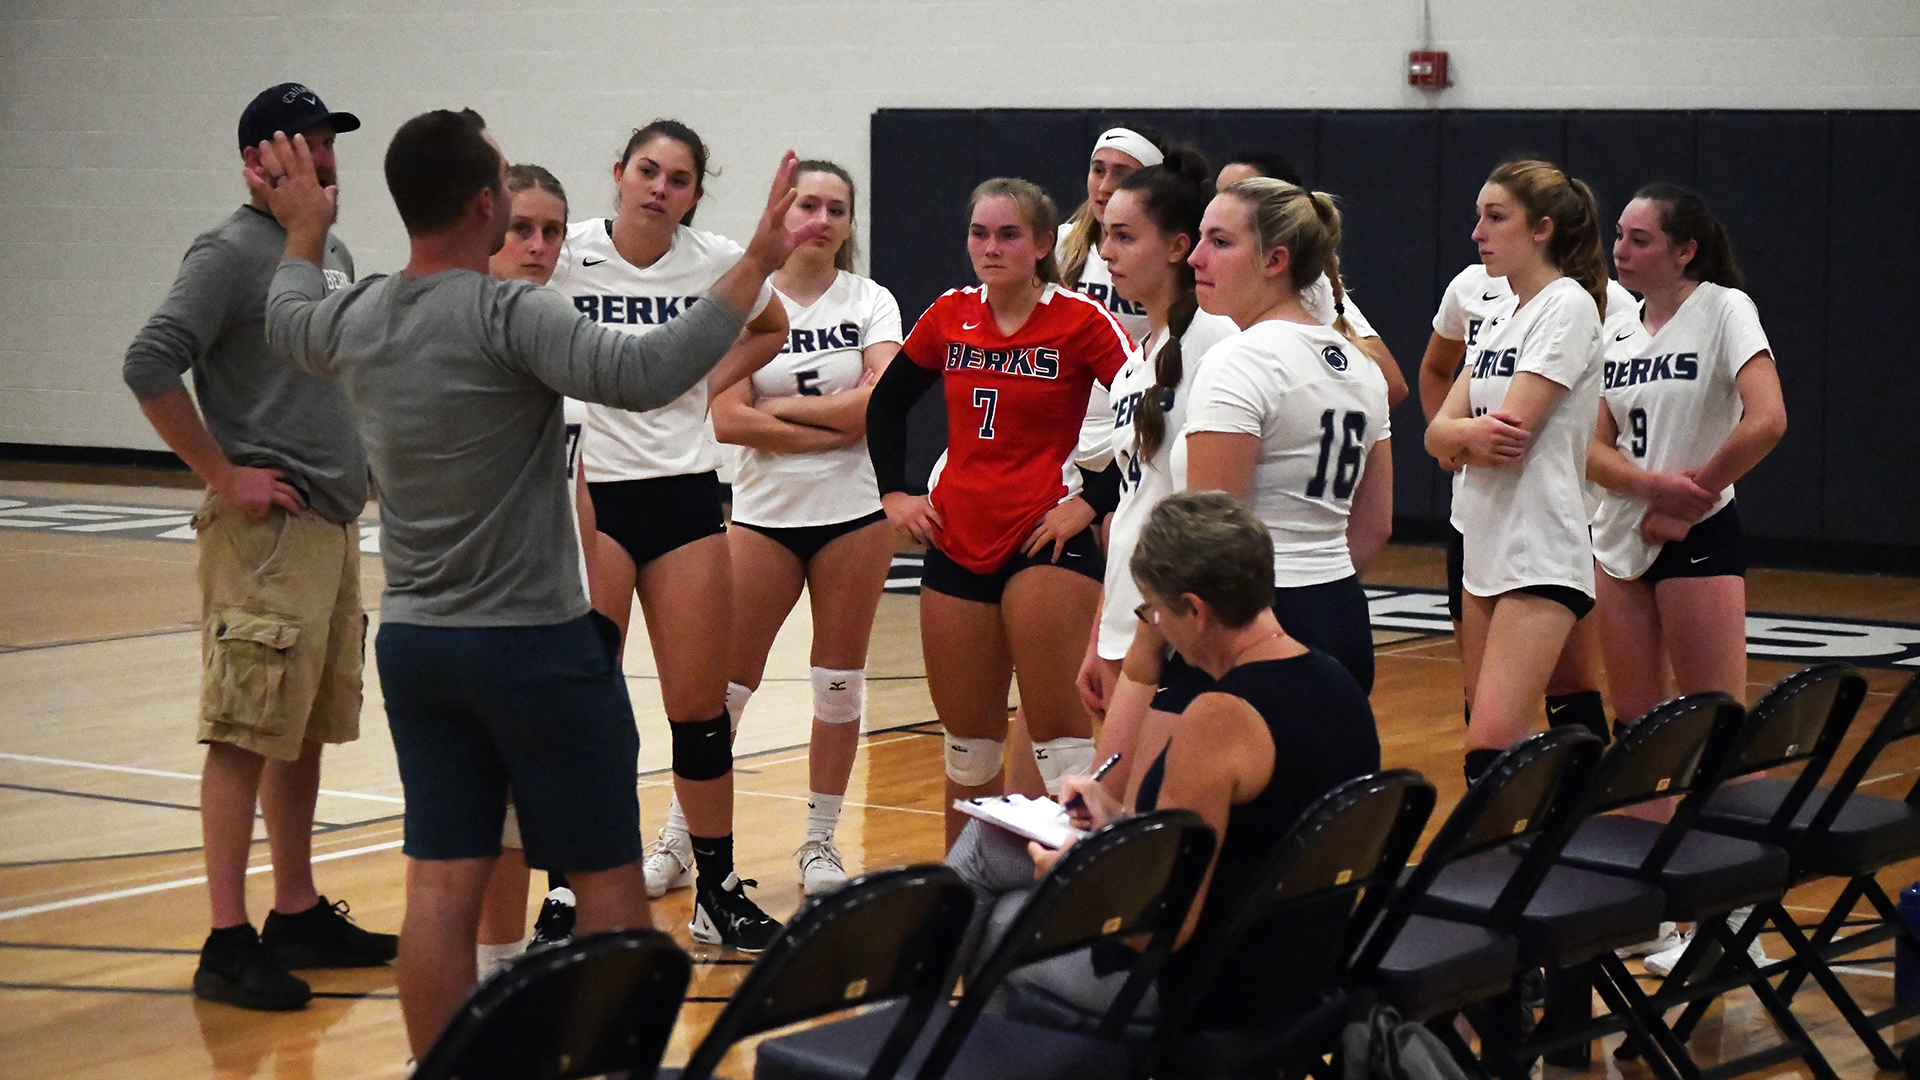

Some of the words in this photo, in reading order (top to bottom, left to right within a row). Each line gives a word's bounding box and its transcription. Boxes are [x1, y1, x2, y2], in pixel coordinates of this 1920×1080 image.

[322, 269, 349, 290] BER
[779, 322, 861, 354] RKS
[945, 343, 1060, 380] BERKS
[1471, 347, 1518, 379] RKS
[1603, 352, 1699, 390] BERKS
[973, 387, 998, 440] 7
[1628, 407, 1647, 458] 9
[1306, 408, 1368, 499] 16
